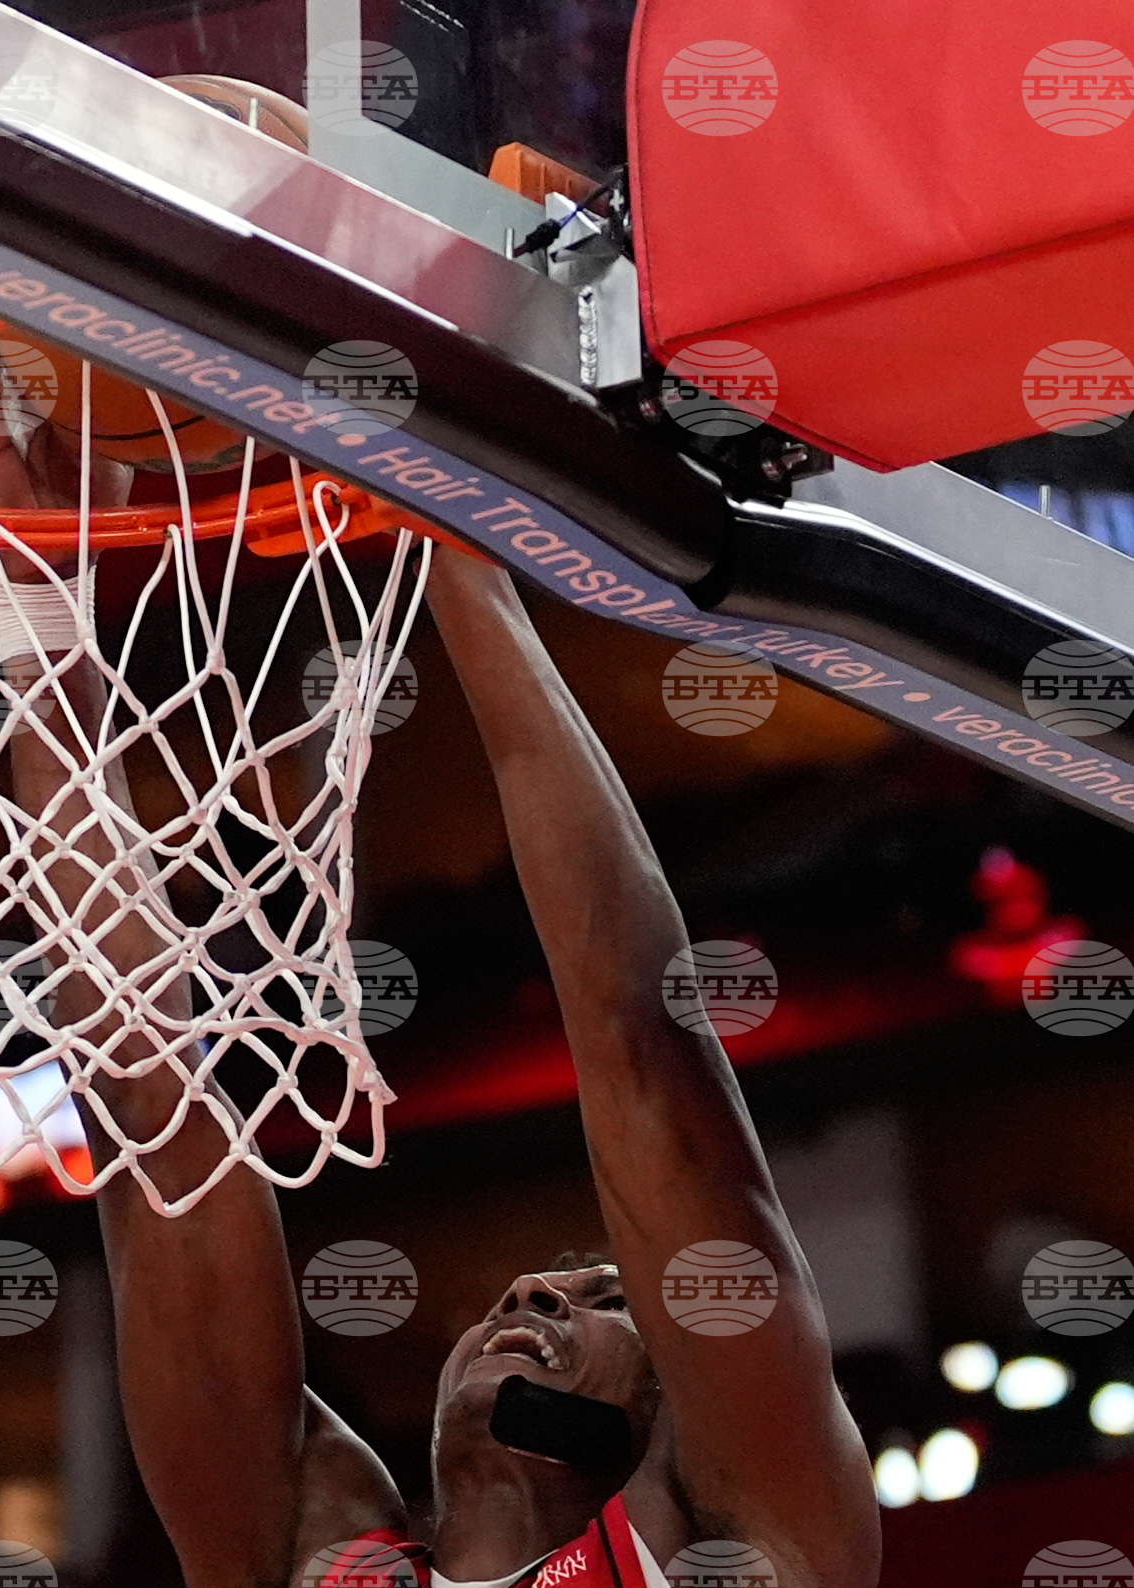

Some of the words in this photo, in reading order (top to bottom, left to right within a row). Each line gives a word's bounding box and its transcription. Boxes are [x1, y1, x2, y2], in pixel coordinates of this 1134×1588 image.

[358, 446, 485, 501] Hair
[471, 496, 744, 638] Transplant
[732, 629, 905, 691] Turkey
